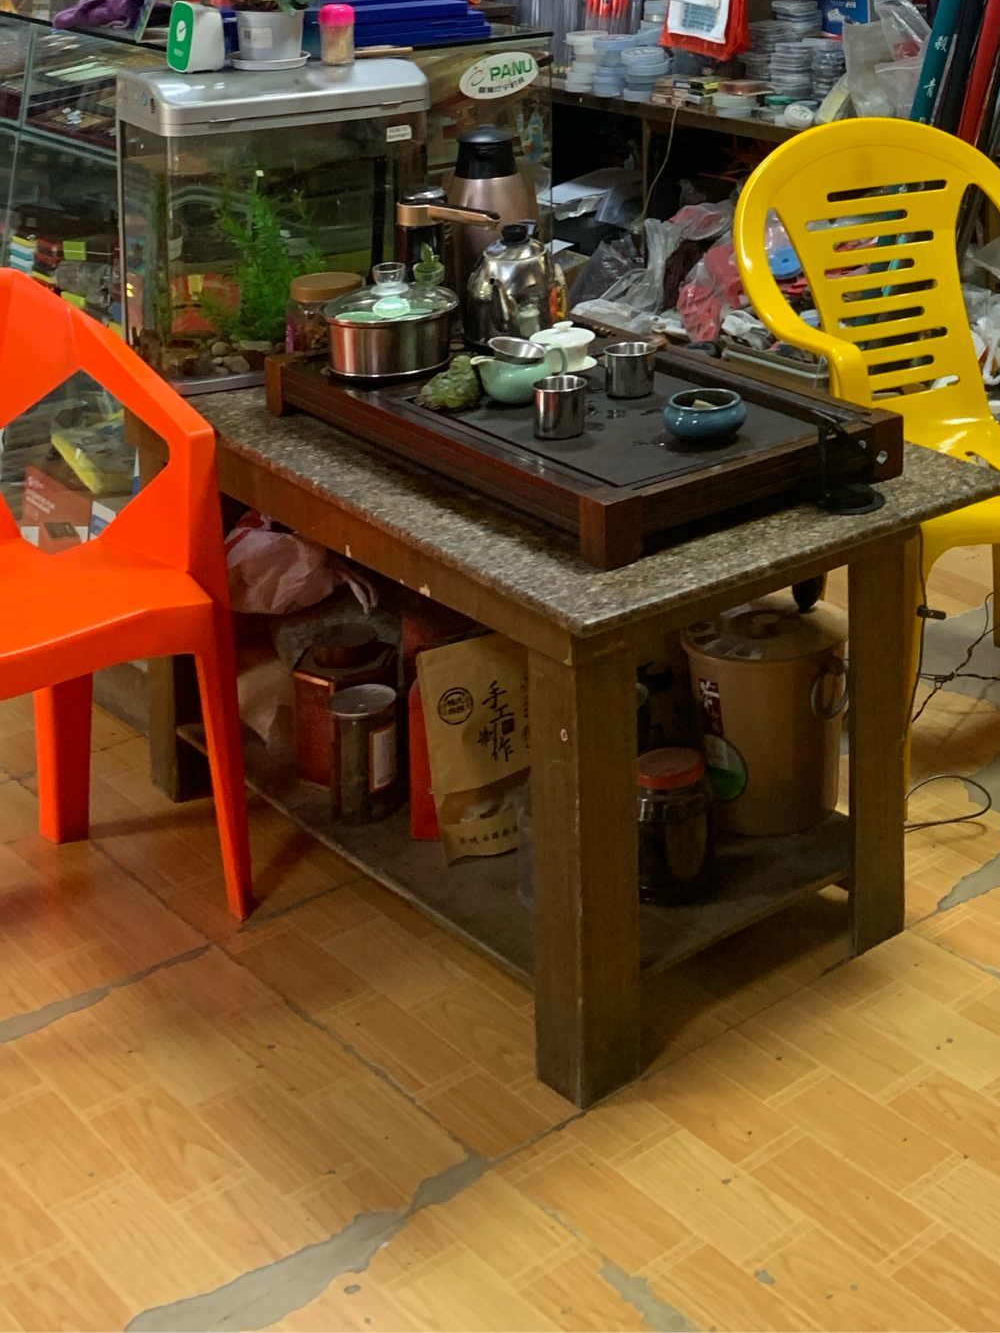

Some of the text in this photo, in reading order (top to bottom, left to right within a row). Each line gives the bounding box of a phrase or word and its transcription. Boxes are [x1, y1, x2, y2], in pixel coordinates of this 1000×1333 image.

[490, 58, 532, 82] PANU
[476, 680, 516, 762] 手工制作
